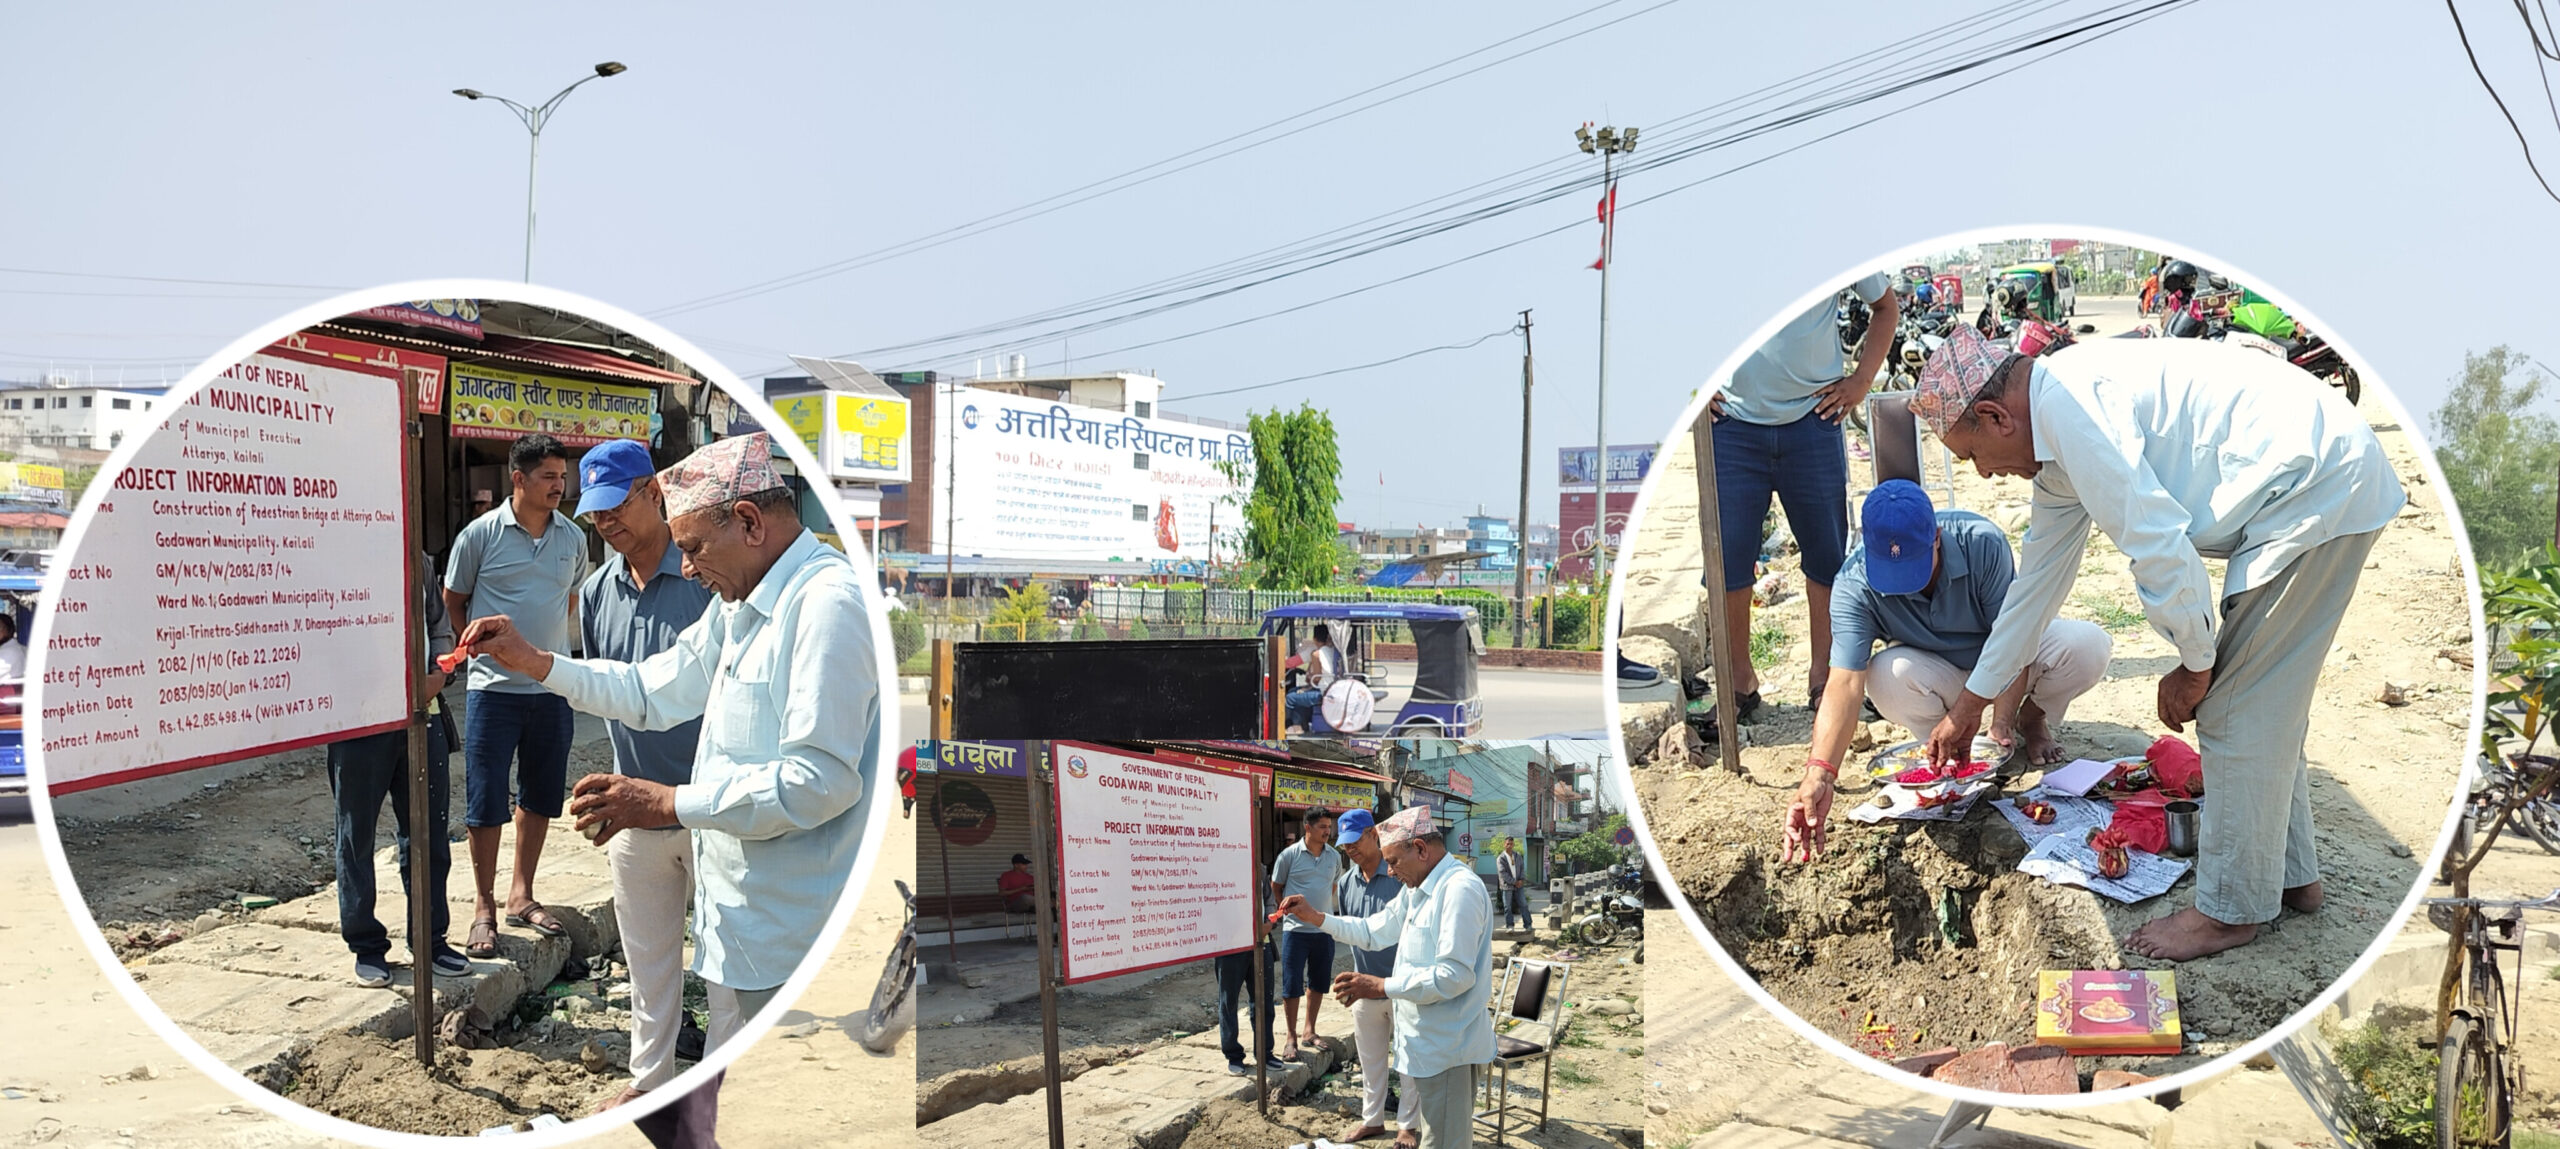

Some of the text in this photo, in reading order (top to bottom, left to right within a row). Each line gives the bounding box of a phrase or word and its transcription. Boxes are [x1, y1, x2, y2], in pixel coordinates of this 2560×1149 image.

[245, 365, 260, 382] OF
[266, 368, 309, 392] NEPAL
[456, 374, 517, 403] जगदम्बा
[521, 379, 552, 406] स्वीट
[557, 388, 583, 410] एण्ड
[588, 386, 648, 416] भोजनालय
[210, 388, 334, 424] MUNICIPALITY
[179, 420, 189, 440] of
[196, 422, 250, 443] Municipal
[260, 429, 301, 445] Executive
[995, 405, 1100, 446] अत्तरिया
[1199, 437, 1222, 461] प्रा.
[234, 450, 264, 464] Kailali
[1591, 456, 1639, 471] XREME
[114, 467, 337, 499] ROJECT INFORMATION BOARD
[153, 500, 232, 517] Construction
[236, 502, 246, 525] of
[251, 504, 300, 520] Pedestrian
[302, 507, 328, 527] Bridge
[331, 509, 340, 521] at
[343, 509, 372, 527] Attariya
[375, 510, 395, 522] Chowk
[156, 530, 210, 549] Godawari
[283, 536, 314, 549] Kailali
[1584, 529, 1622, 547] Npal
[96, 565, 112, 579] No
[157, 594, 187, 609] Ward
[341, 588, 370, 602] Kailali
[49, 632, 101, 650] ntractor
[44, 669, 64, 684] ate
[68, 665, 81, 688] of
[87, 660, 146, 688] Agrement
[227, 650, 249, 670] (Feb
[42, 699, 100, 723] ompletion
[106, 695, 133, 710] Date
[95, 725, 139, 744] Amount
[255, 704, 284, 724] (With
[286, 700, 305, 714] VAT
[318, 694, 333, 709] PS)
[1122, 763, 1206, 786] GOVERNMENT OF NEPAL
[1099, 775, 1219, 802] GODAWARI MUNICIPALITY
[1121, 796, 1138, 806] Office
[1142, 798, 1148, 809] of
[1150, 800, 1177, 810] Municipal
[1104, 821, 1220, 839] PROJECT INFORMATION BOARD
[1068, 835, 1092, 848] Project
[1094, 836, 1111, 846] Name
[1129, 838, 1168, 847] Construction
[1170, 839, 1176, 850] of
[1130, 853, 1158, 862] Godawari
[1069, 870, 1100, 878] Contract
[1101, 870, 1110, 878] No
[1070, 886, 1098, 895] Location
[1131, 884, 1147, 892] Ward
[1071, 903, 1105, 913] Contractor
[1072, 920, 1087, 929] Date
[1088, 919, 1095, 931] of
[1072, 935, 1104, 947] Completion
[1107, 934, 1120, 942] Date
[1074, 953, 1098, 962] Contract
[1101, 949, 1123, 958] Amount
